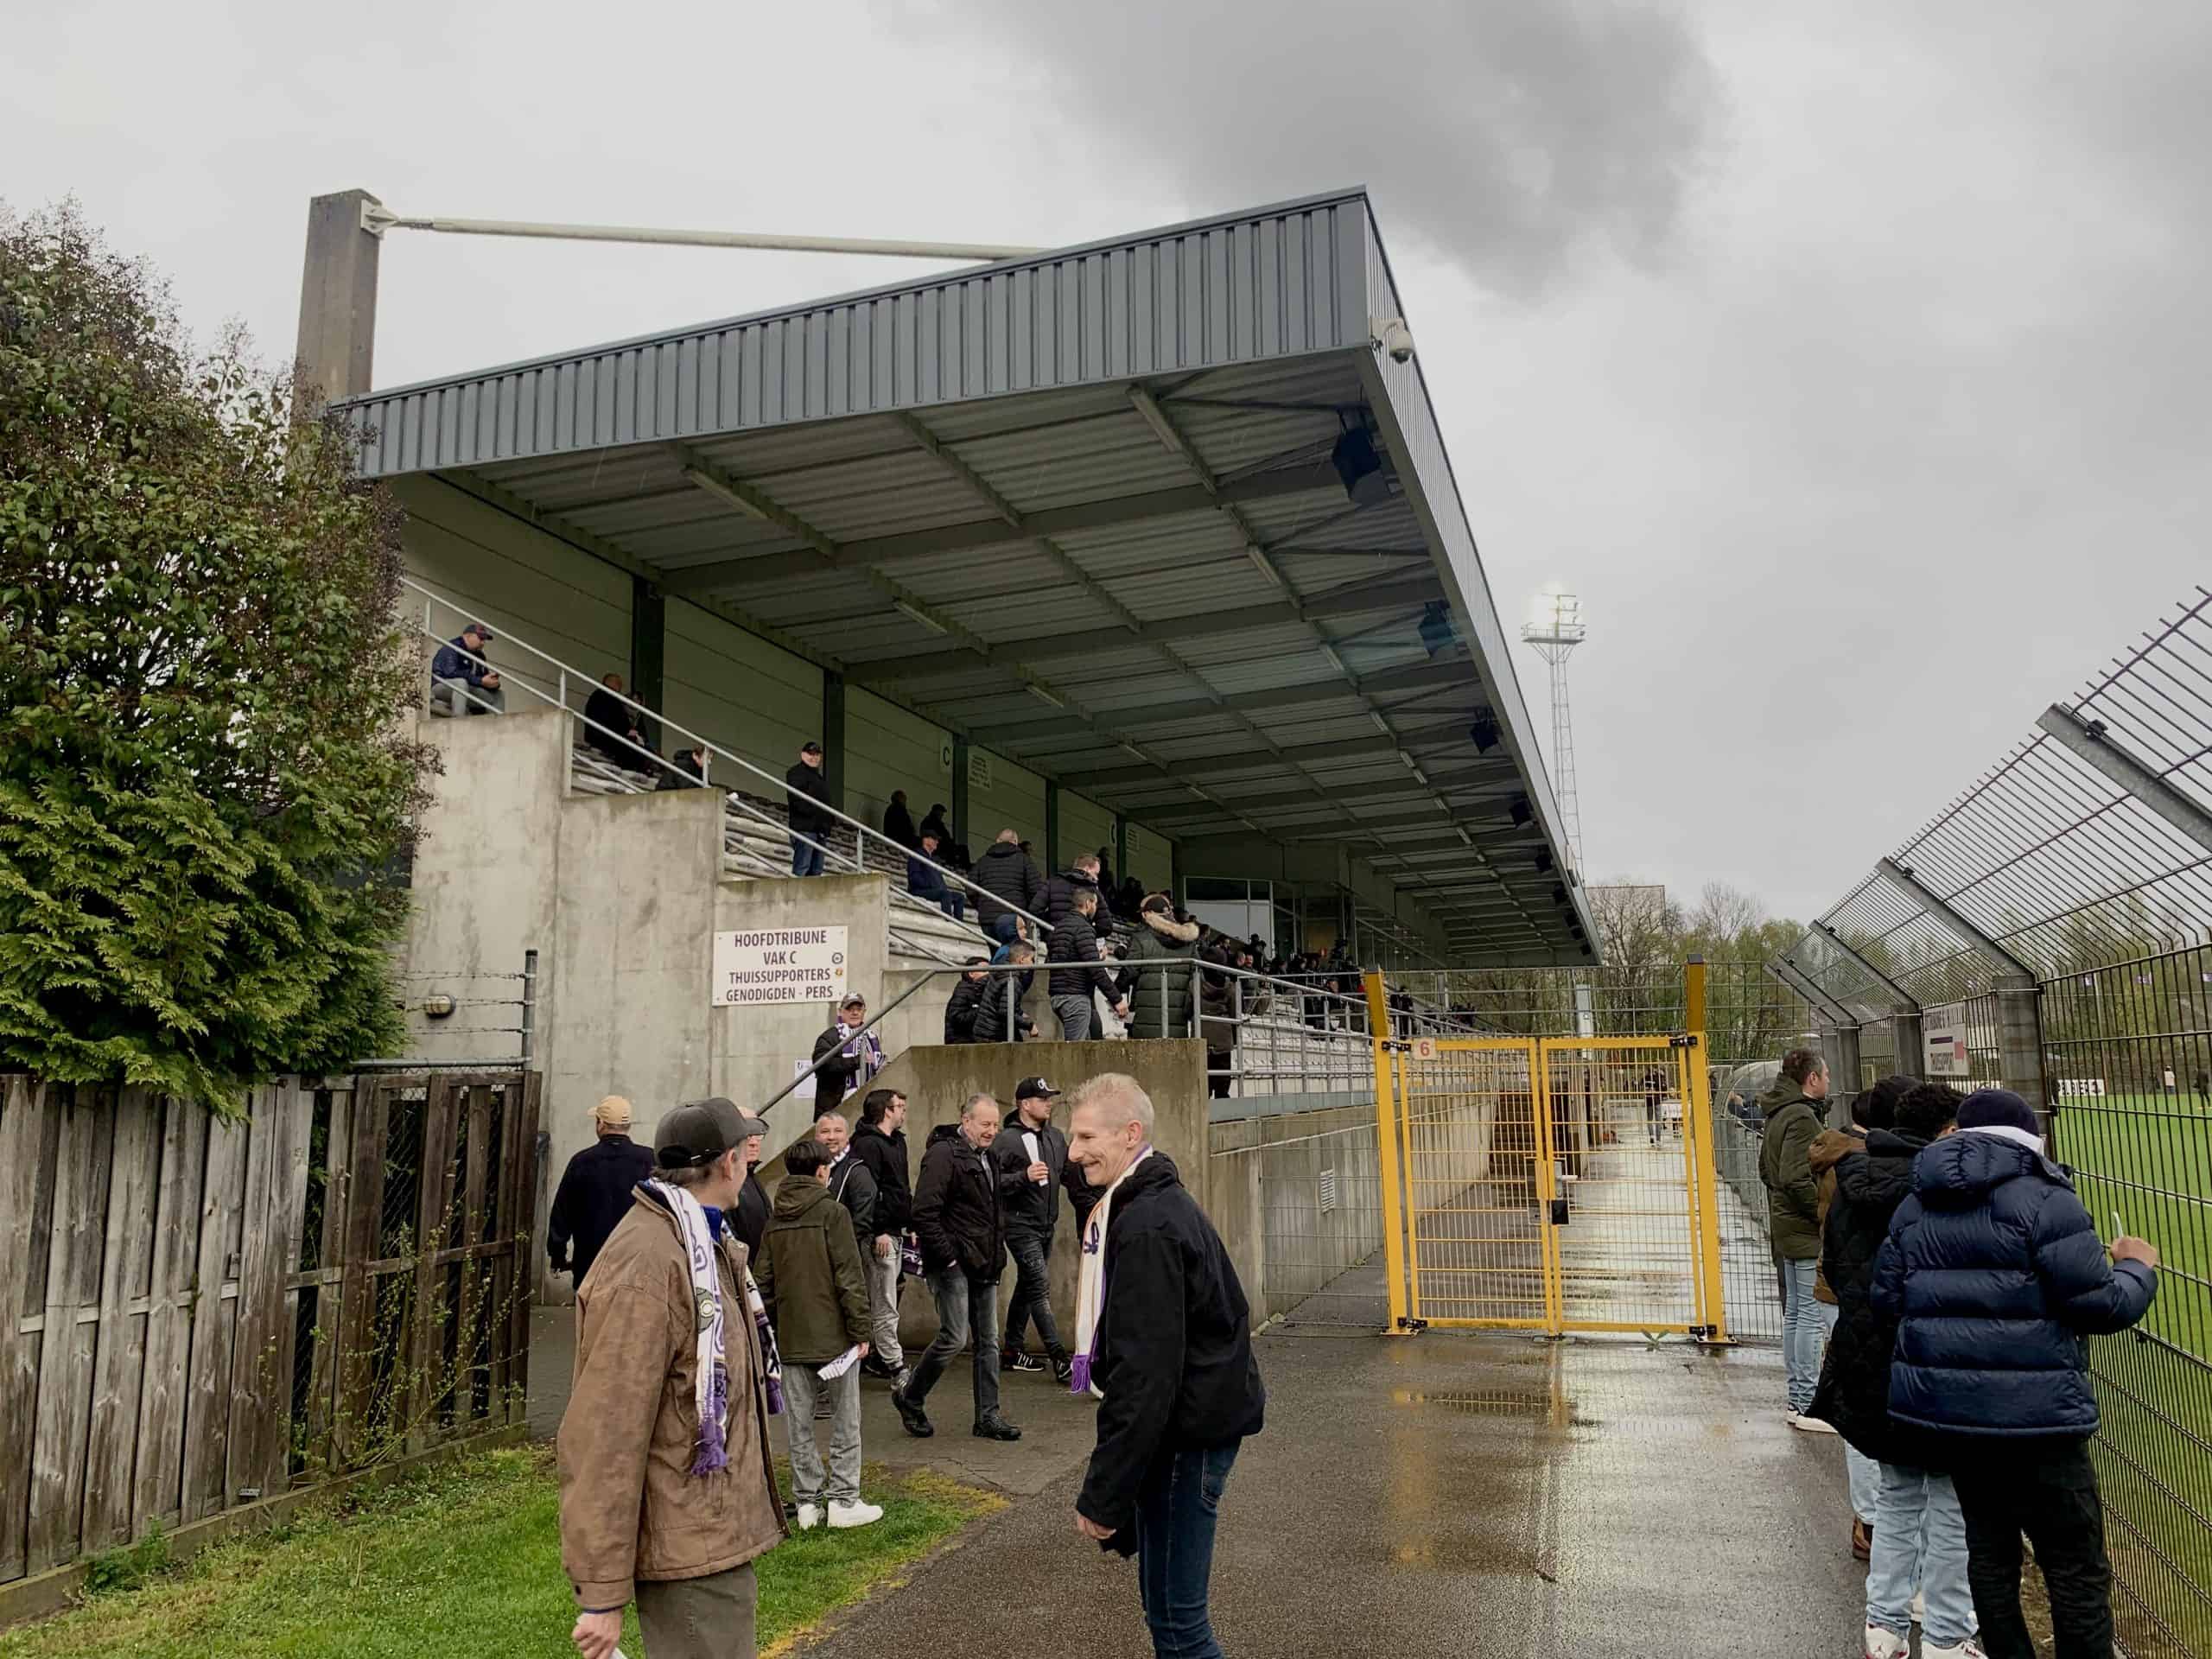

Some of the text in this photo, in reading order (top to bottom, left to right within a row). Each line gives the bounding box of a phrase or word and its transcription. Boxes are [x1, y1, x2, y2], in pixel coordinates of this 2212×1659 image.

[943, 746, 950, 766] C
[734, 930, 827, 947] HOOFDTRIBUNE
[763, 950, 798, 965] VAK C
[729, 968, 830, 984] THUISSUPPORTERS
[726, 988, 795, 1002] GENODIGDEN
[805, 985, 833, 999] PERS
[1420, 1041, 1430, 1056] 6
